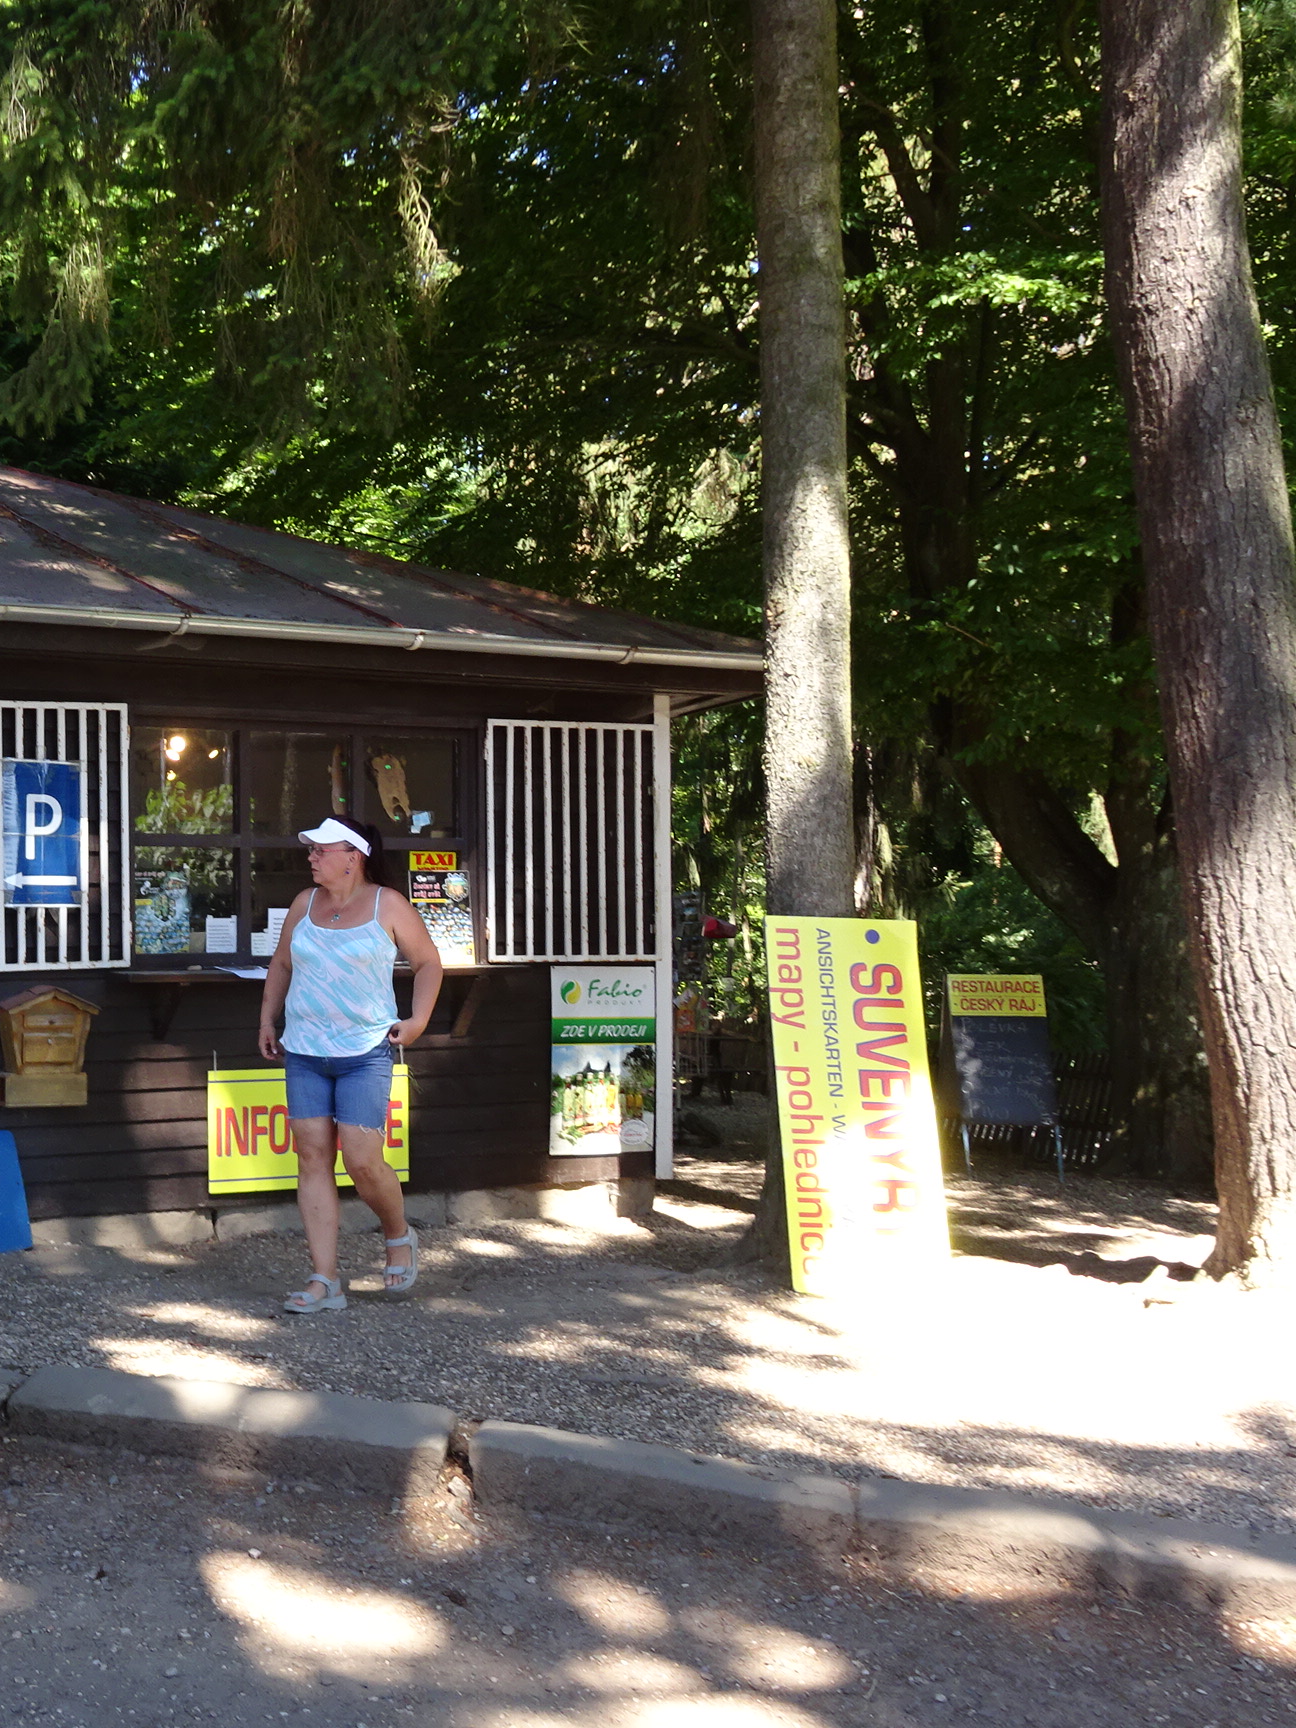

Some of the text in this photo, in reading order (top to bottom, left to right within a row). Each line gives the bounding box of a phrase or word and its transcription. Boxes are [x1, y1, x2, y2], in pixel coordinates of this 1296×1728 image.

[25, 793, 63, 861] P
[412, 852, 454, 866] TAXI
[588, 979, 642, 998] Fabio
[769, 928, 806, 1029] mapy
[951, 980, 1041, 993] RESTAURACE
[816, 928, 844, 1098] ANSICHTSKARTEN
[960, 995, 1037, 1012] ČESKÝ RÁJ
[560, 1025, 648, 1038] ZDE V PRODEJI
[849, 962, 918, 1236] SUVENYR
[216, 1100, 403, 1157] INFOE
